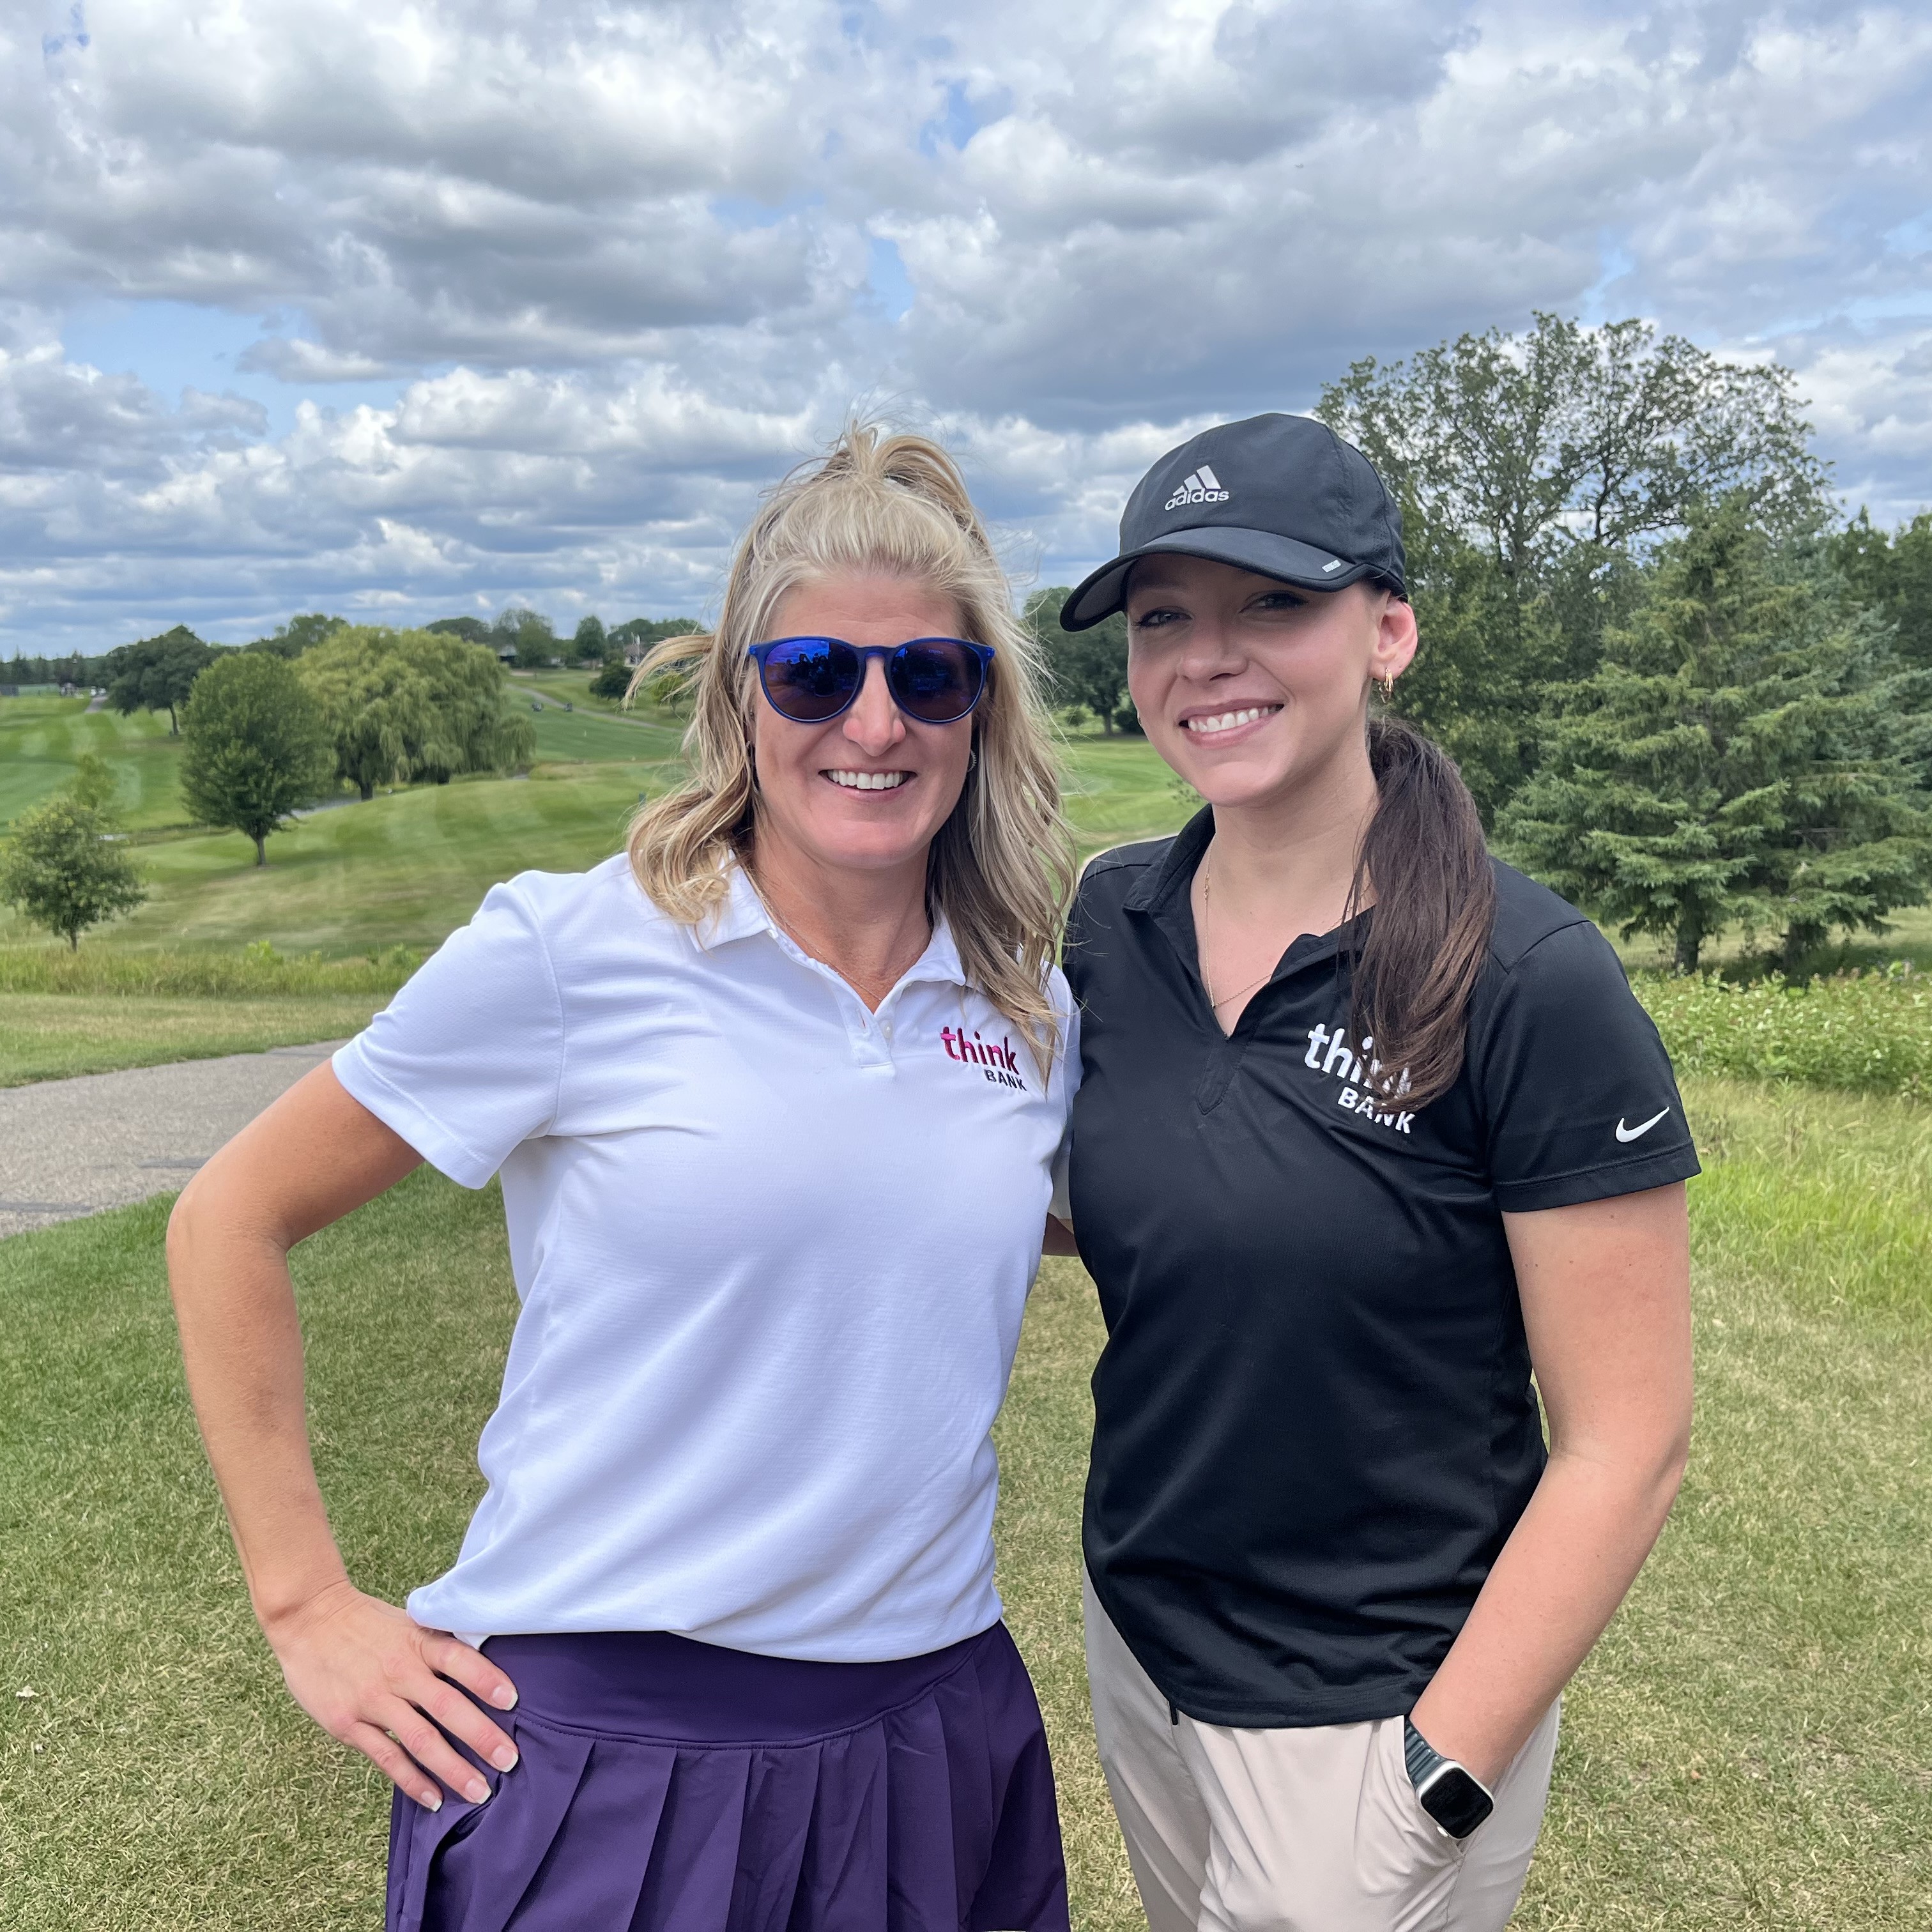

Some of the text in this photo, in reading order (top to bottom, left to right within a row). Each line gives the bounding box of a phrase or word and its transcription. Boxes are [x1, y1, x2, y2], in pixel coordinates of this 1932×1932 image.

[1165, 488, 1229, 511] adidas
[940, 1026, 1020, 1075] think
[984, 1069, 1027, 1091] BANK
